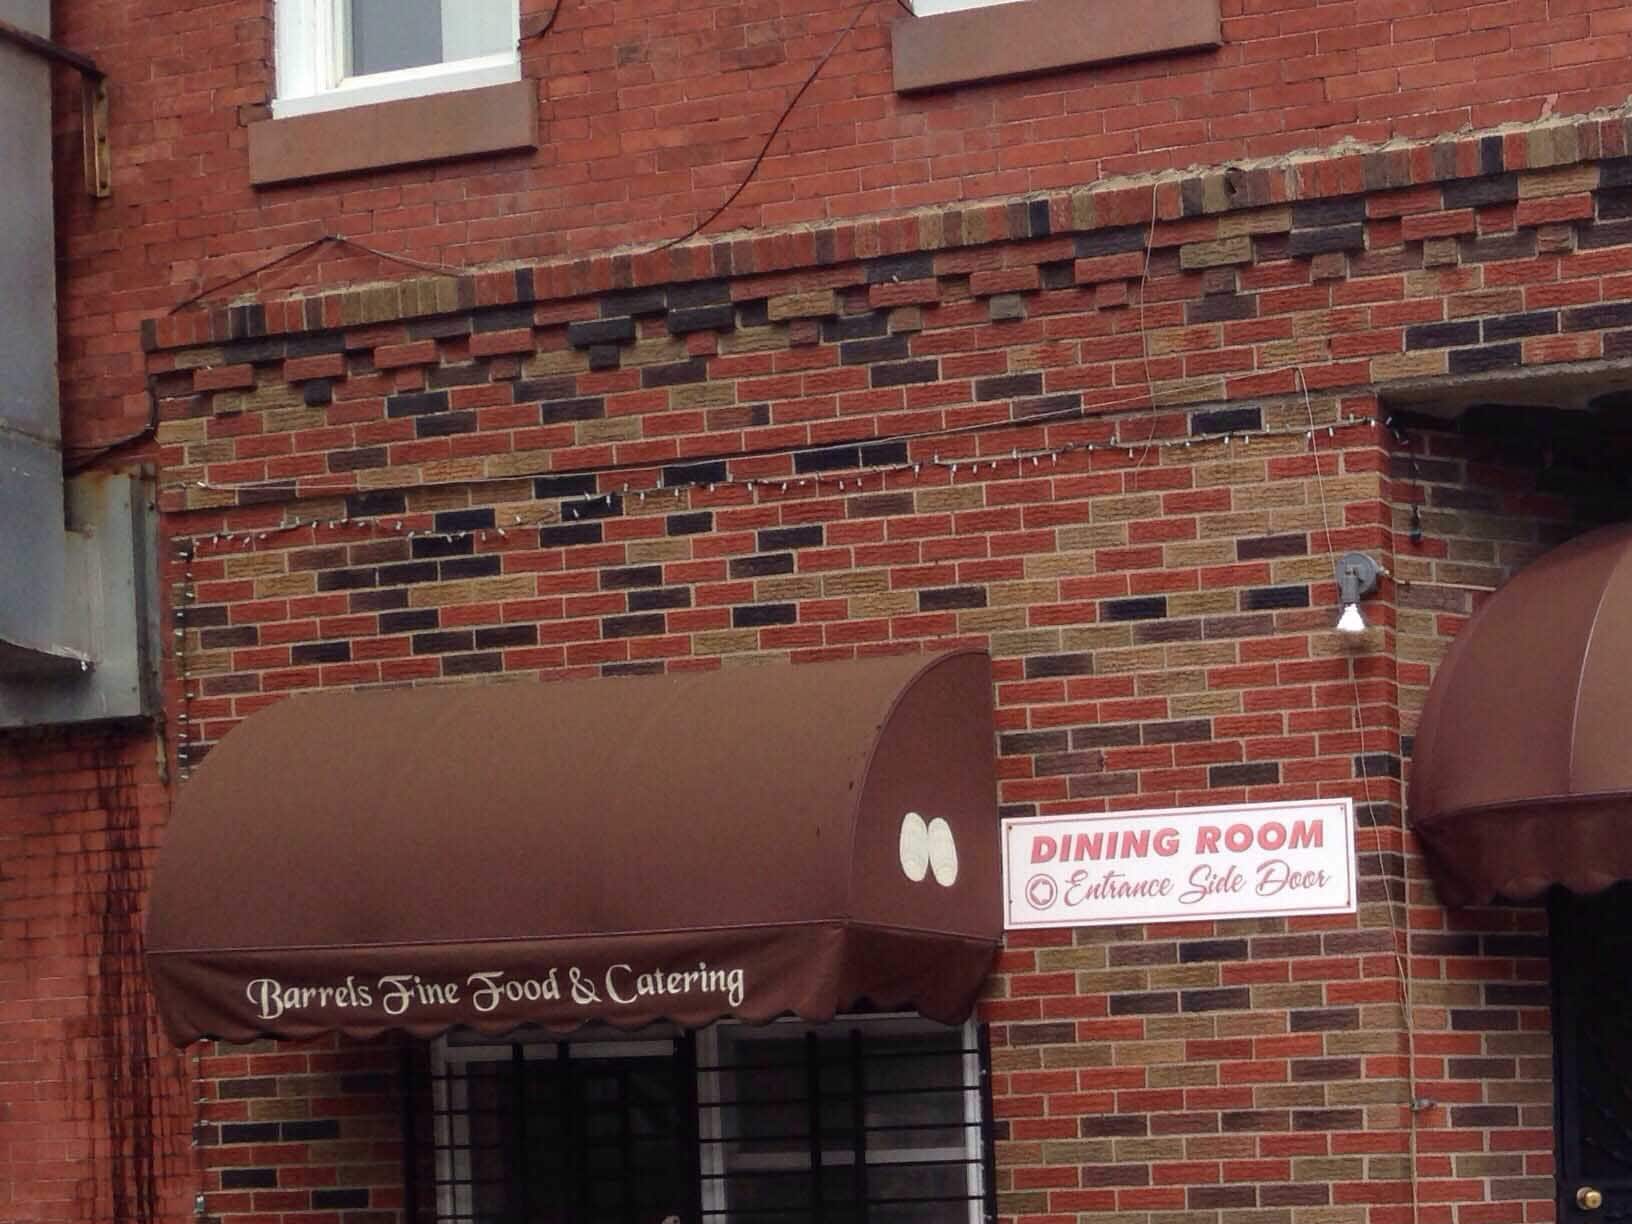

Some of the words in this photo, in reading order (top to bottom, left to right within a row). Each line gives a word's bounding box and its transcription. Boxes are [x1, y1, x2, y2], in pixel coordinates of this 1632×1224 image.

[1030, 827, 1180, 864] DINING
[1195, 819, 1324, 855] ROOM
[1063, 869, 1175, 907] Entrance
[1178, 864, 1246, 904] Side
[1255, 859, 1331, 897] Door
[378, 975, 460, 1015] Fine
[466, 967, 561, 1012] Food
[570, 967, 602, 1004] &
[605, 961, 745, 1006] Catering
